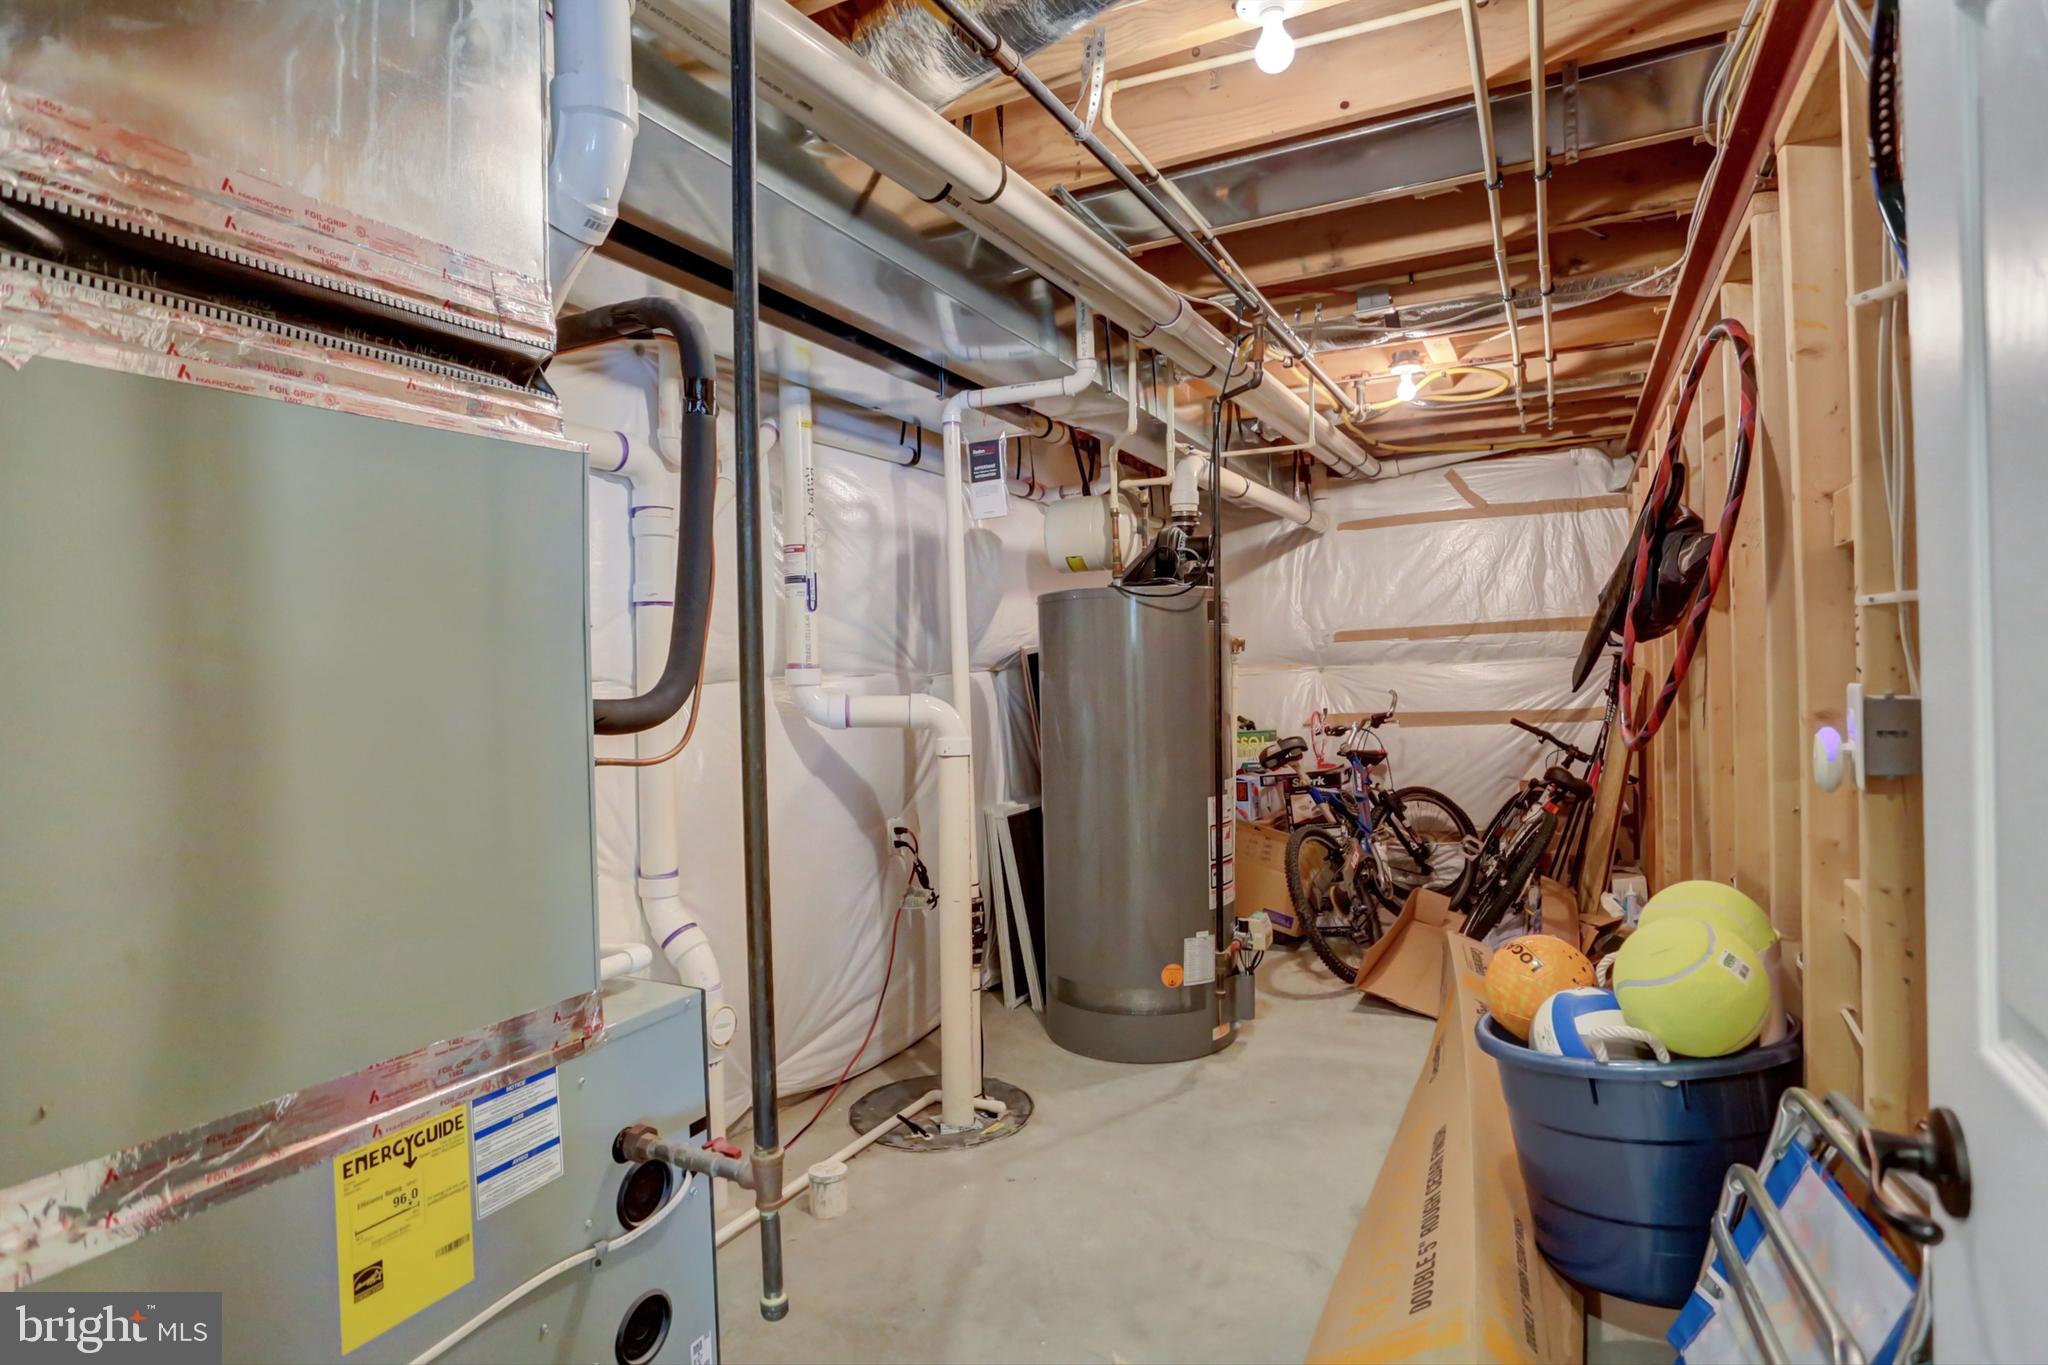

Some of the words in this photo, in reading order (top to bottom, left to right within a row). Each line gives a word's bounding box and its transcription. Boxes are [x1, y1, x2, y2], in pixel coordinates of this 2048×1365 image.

[1292, 775, 1326, 788] Srk
[392, 1187, 419, 1208] 96.0
[1419, 1190, 1442, 1239] ROUGH
[1409, 1251, 1437, 1315] DOUBLE
